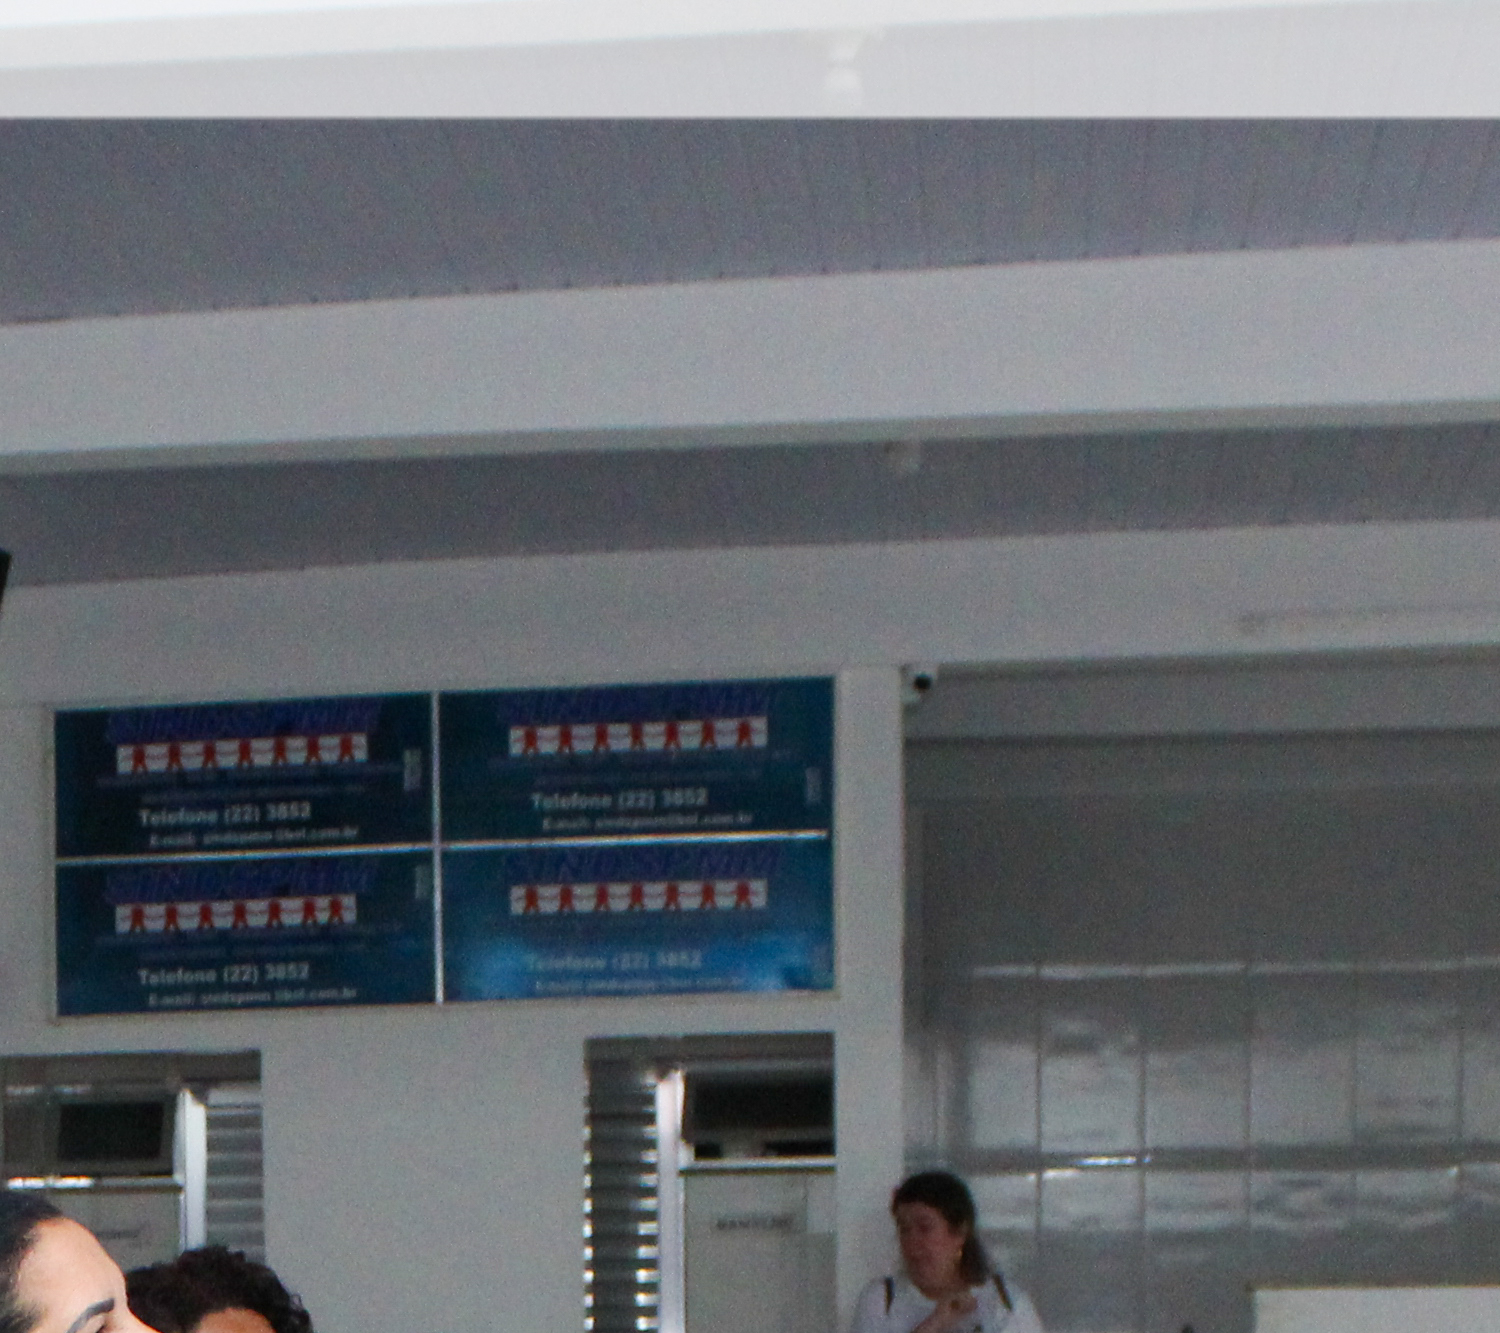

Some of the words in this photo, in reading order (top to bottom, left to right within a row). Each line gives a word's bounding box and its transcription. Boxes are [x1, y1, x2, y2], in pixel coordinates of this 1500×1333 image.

[531, 791, 613, 810] Telefone
[138, 806, 218, 827] Telefone
[224, 803, 260, 823] (22)
[137, 967, 217, 986] Telefone
[222, 964, 260, 984] (22)
